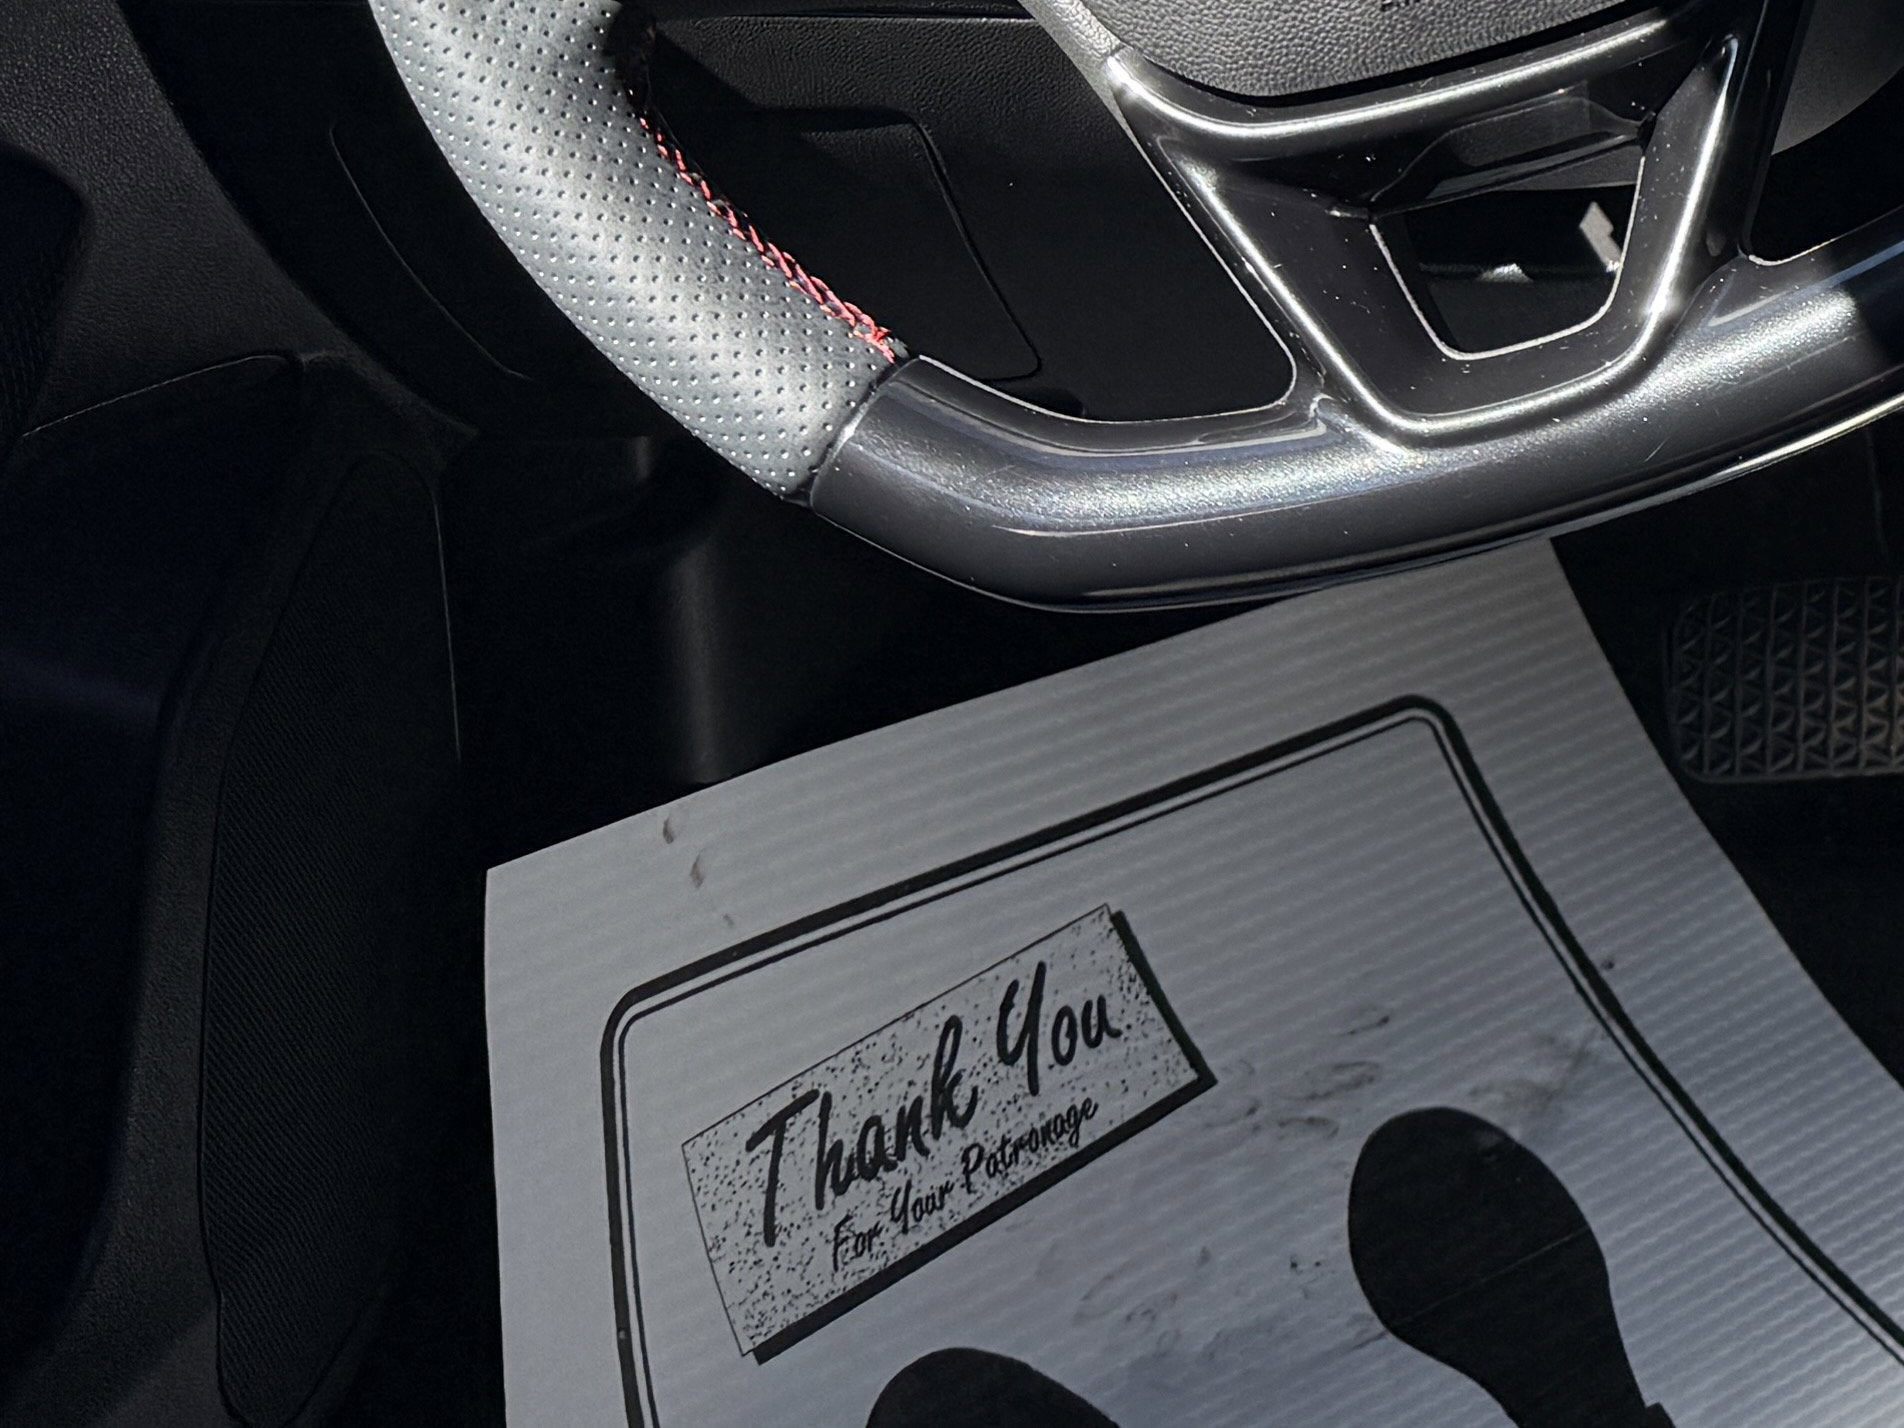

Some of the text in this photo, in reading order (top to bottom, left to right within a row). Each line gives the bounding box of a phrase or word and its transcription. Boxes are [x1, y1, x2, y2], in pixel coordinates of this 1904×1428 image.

[745, 960, 1122, 1248] Thank You
[832, 1096, 1100, 1272] For Your Patronage
